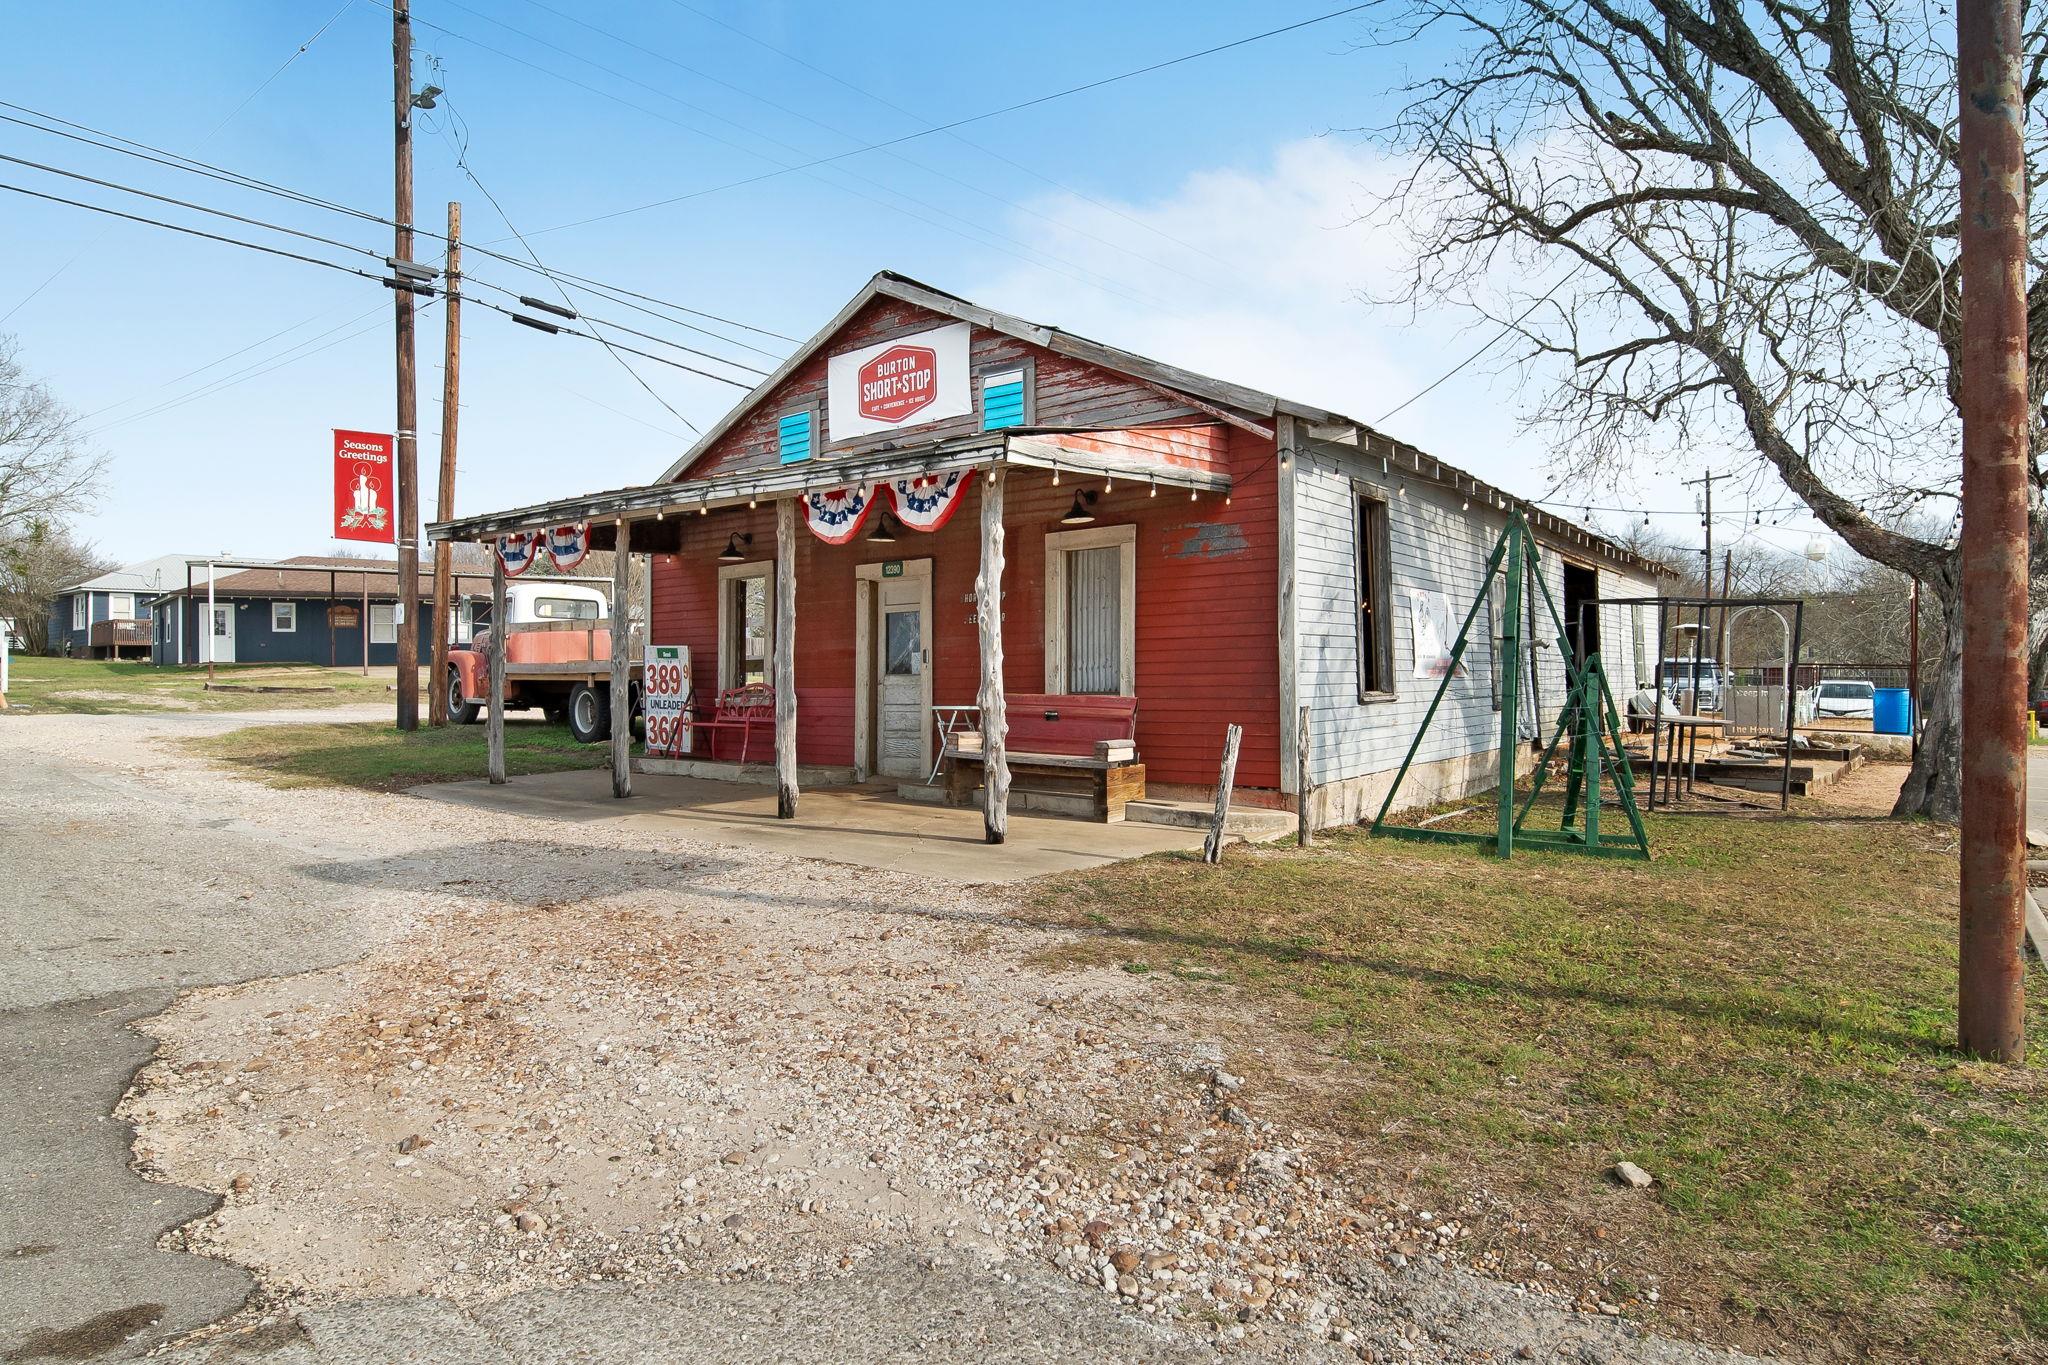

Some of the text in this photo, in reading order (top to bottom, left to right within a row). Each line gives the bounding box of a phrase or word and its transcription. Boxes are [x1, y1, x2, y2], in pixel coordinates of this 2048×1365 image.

[877, 356, 915, 377] BURTON
[864, 369, 930, 402] SHORT STOP
[344, 440, 383, 451] Seasons
[339, 450, 387, 463] Greetings
[647, 664, 680, 694] 389
[650, 699, 686, 710] UNLEADED
[1732, 726, 1747, 734] The
